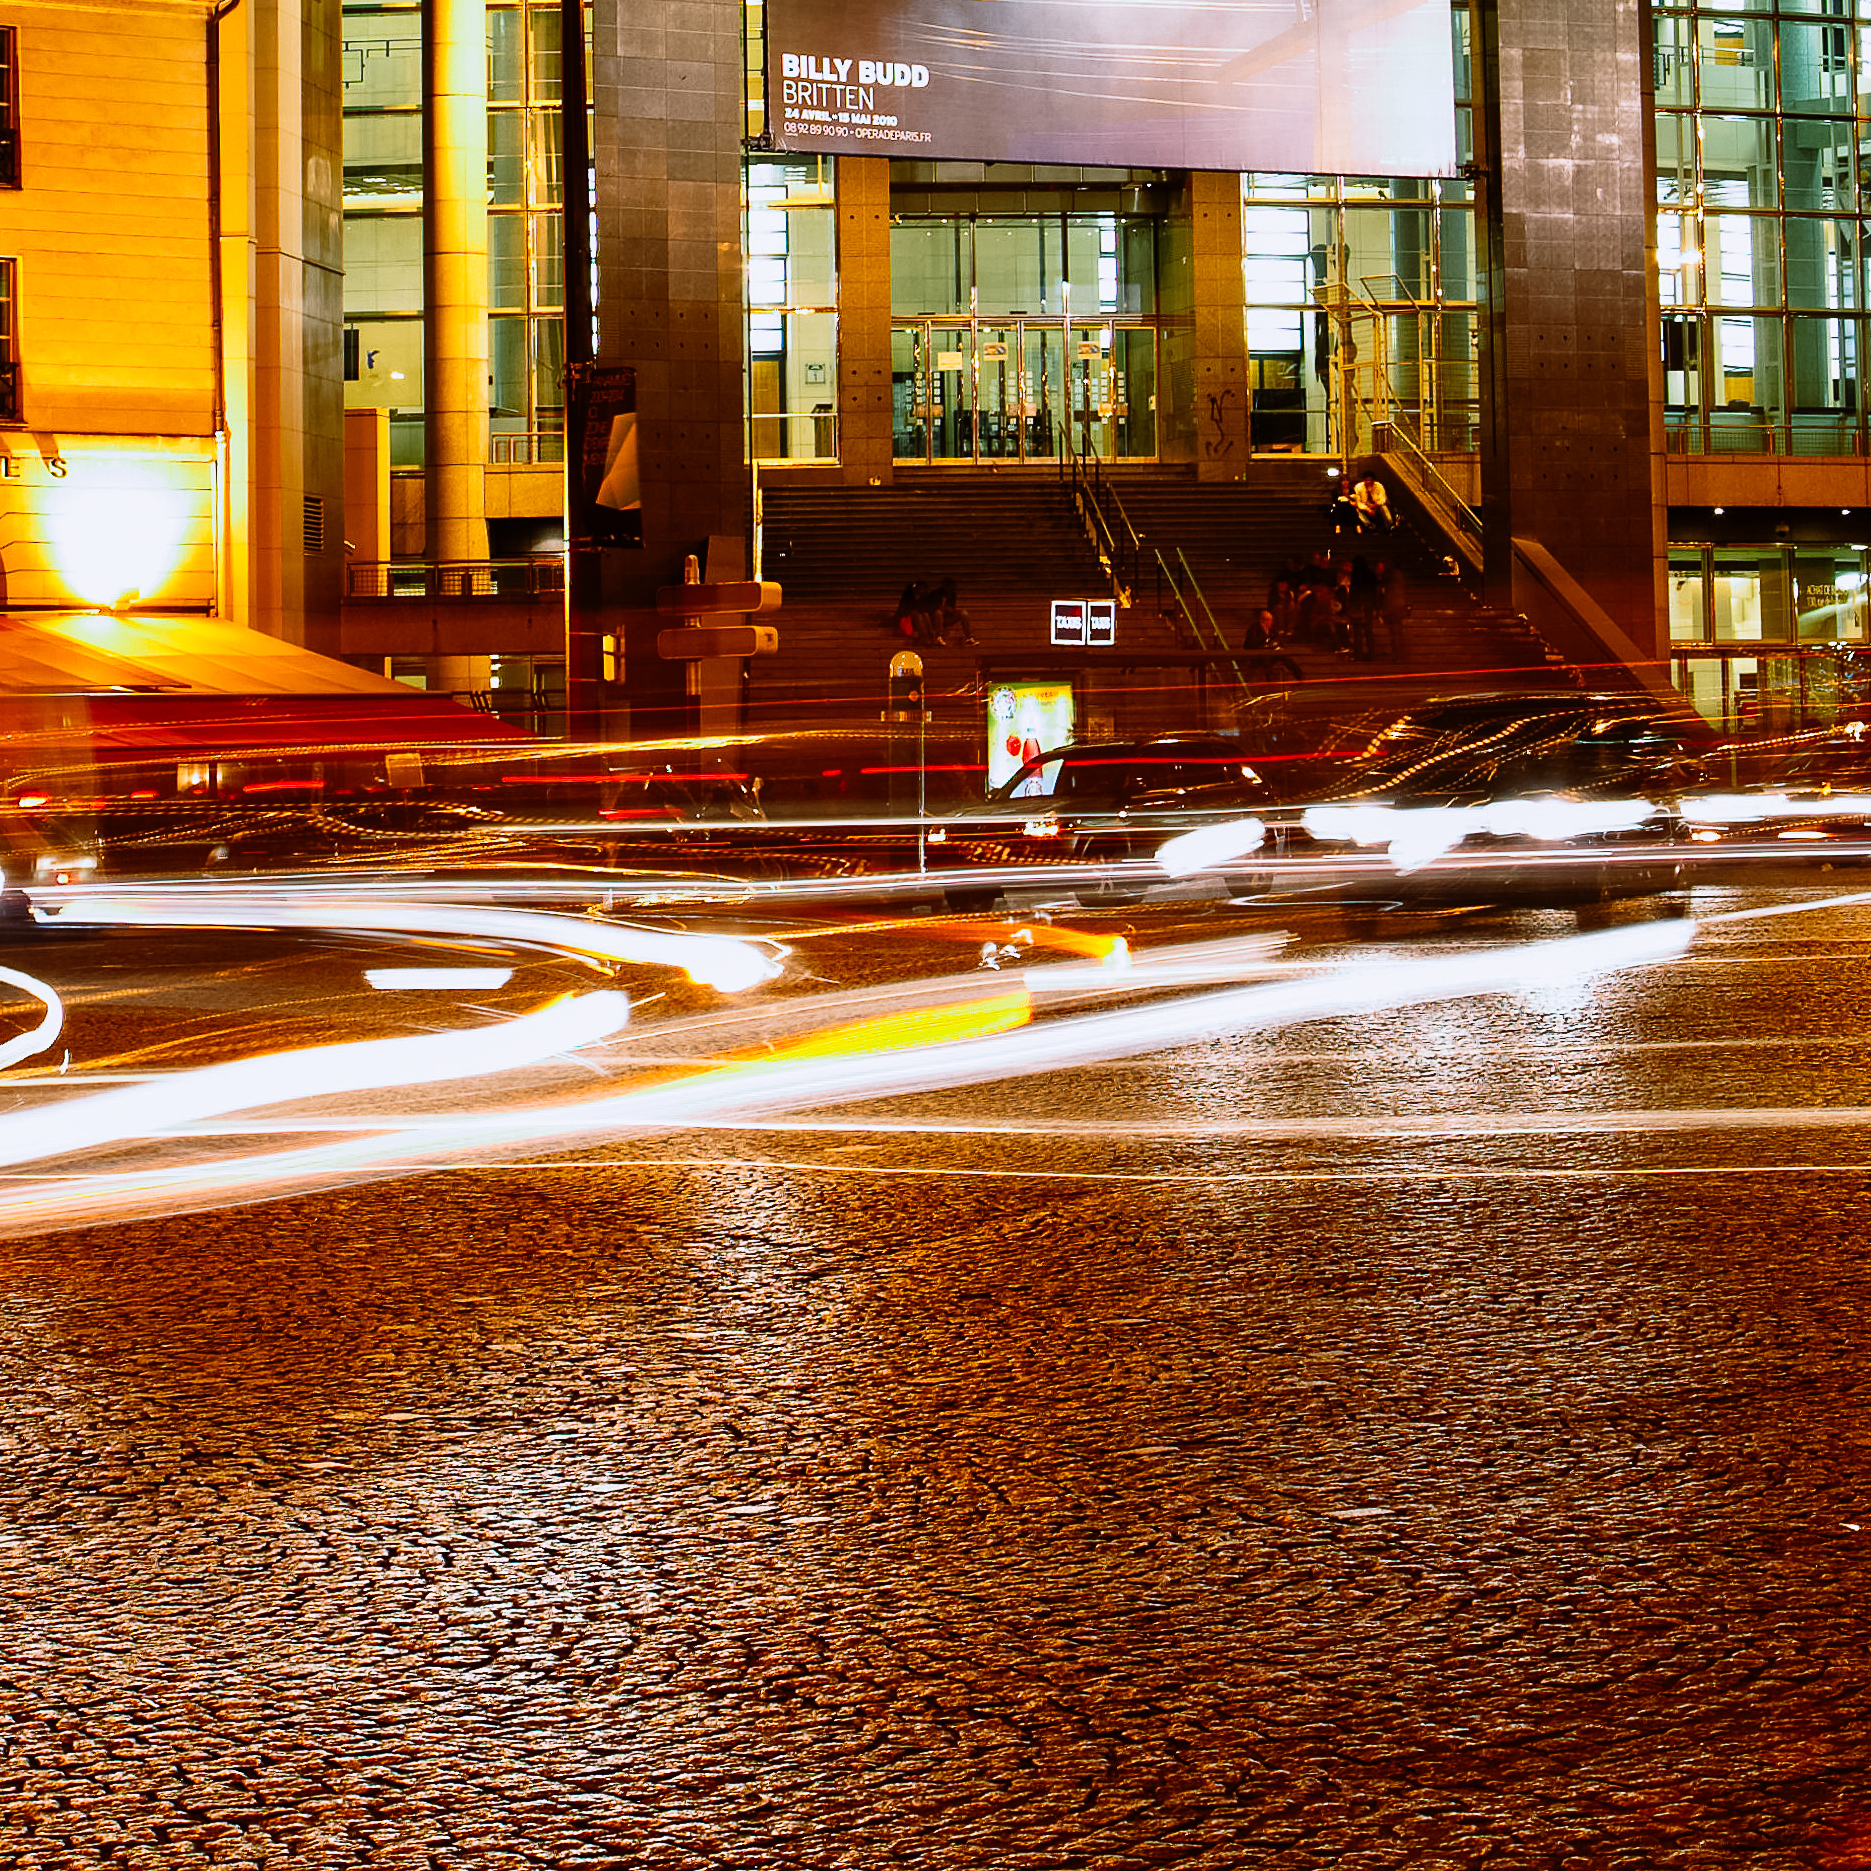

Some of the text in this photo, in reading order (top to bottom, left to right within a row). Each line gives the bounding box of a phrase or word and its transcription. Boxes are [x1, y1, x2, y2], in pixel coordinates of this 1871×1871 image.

[782, 53, 930, 88] BILLY BUDD
[783, 80, 874, 111] BRITTEN
[784, 107, 800, 119] 24
[801, 109, 832, 122] AVRIL
[851, 113, 871, 124] MAI
[872, 115, 898, 126] 2010
[783, 121, 797, 133] 08
[797, 123, 809, 134] 92
[810, 124, 822, 135] 89
[823, 125, 835, 136] 90
[835, 126, 849, 137] 90
[855, 128, 932, 142] OPERADEPARIS.FR
